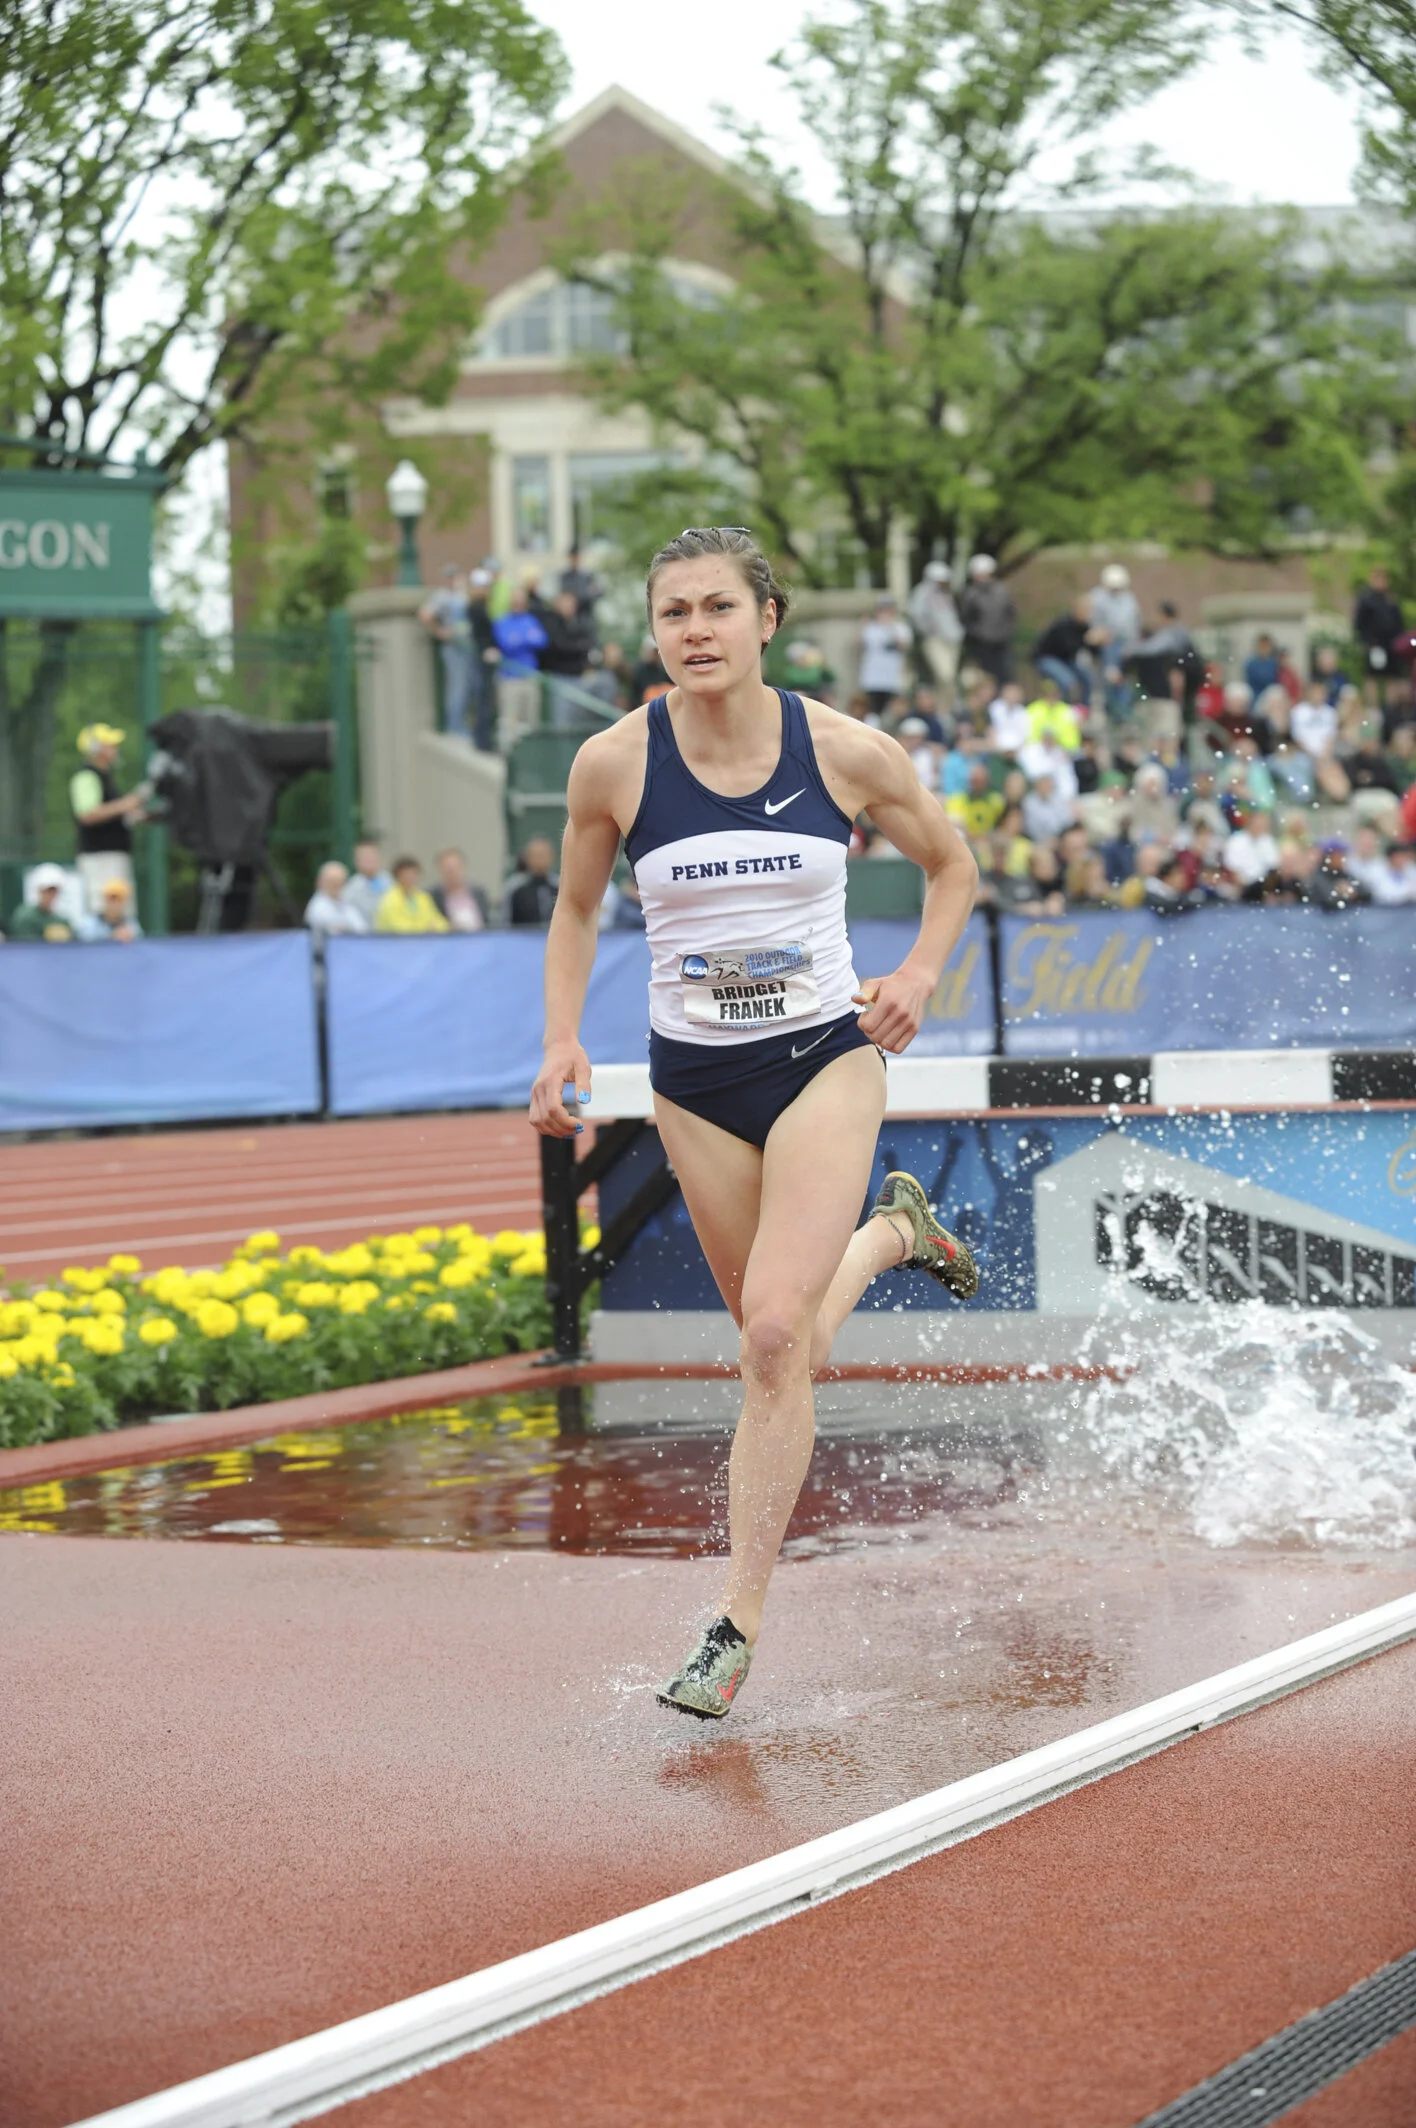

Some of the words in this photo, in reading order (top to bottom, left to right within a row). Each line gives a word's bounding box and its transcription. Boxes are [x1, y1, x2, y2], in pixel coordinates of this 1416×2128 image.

[0, 519, 109, 569] GON
[671, 861, 728, 880] PENN
[735, 854, 802, 874] STATE
[745, 953, 763, 962] 2010
[765, 945, 801, 960] OUTDOOR
[747, 960, 772, 971] TRACK
[782, 954, 803, 964] FIELD
[684, 966, 708, 976] NCAA
[1003, 924, 1153, 1016] Field
[712, 981, 787, 1000] BRIDGET
[720, 997, 786, 1020] FRANEK
